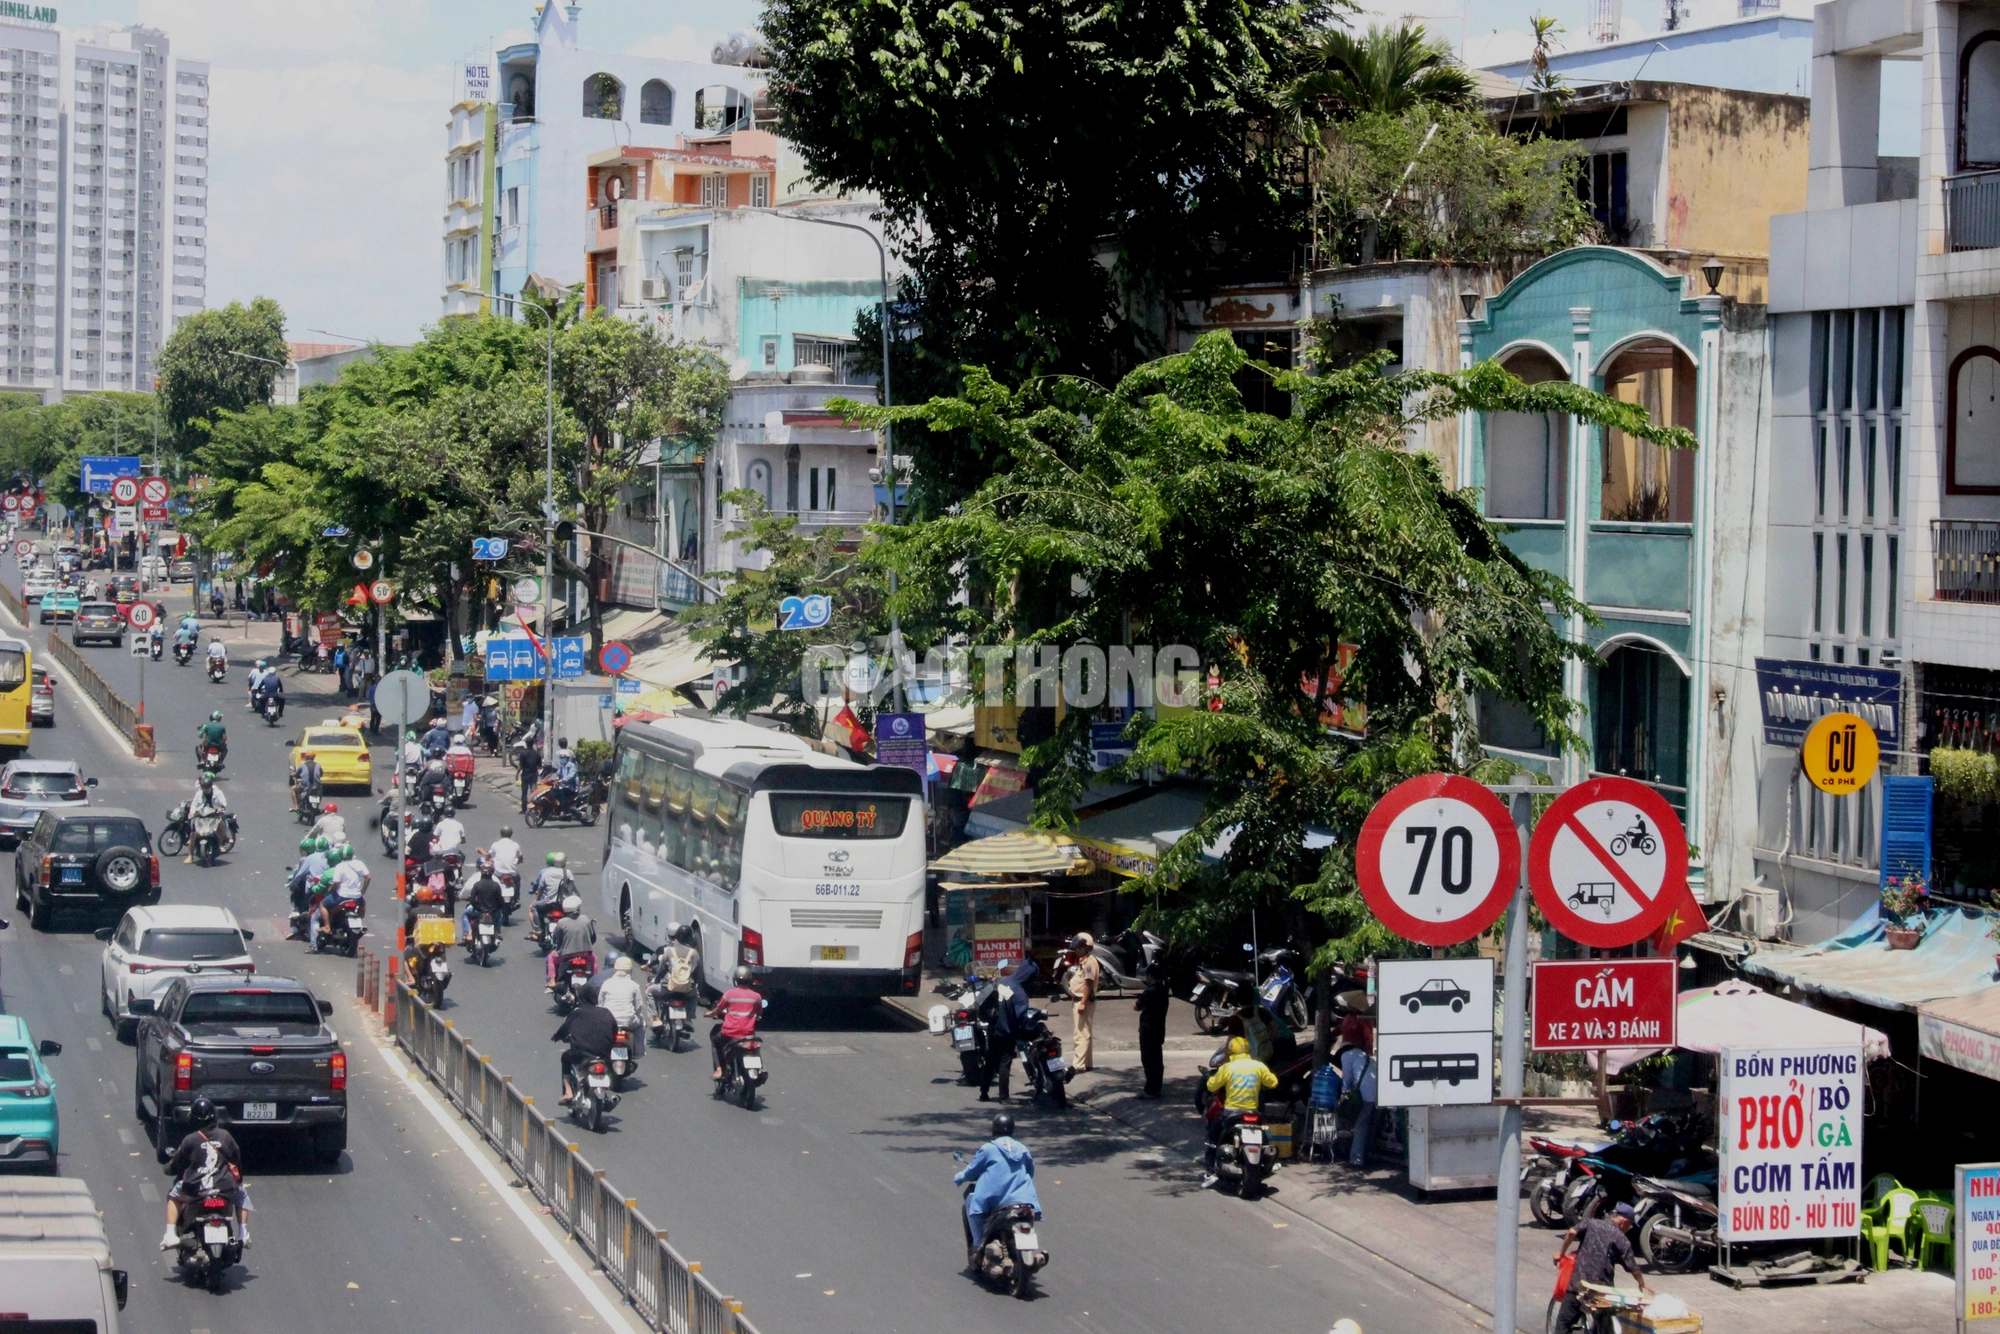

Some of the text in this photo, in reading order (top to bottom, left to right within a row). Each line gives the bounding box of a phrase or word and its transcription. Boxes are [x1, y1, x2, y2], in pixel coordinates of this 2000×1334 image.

[466, 66, 490, 78] HOTEL
[467, 80, 489, 88] MINH
[119, 484, 132, 497] 70
[376, 586, 388, 597] 50
[135, 609, 147, 622] 60
[849, 667, 871, 679] CIH
[1827, 724, 1857, 773] CŨ
[802, 810, 855, 829] QUANG
[1405, 826, 1473, 896] 70
[815, 884, 860, 896] 66B-011.22
[977, 940, 1006, 951] BÁNH
[981, 951, 1017, 959] HEO QUAY
[1575, 968, 1634, 1009] CẤM
[1548, 1016, 1660, 1040] XE 2 VÀ 3 BÁNH
[1735, 1050, 1857, 1078] BỐN PHƯƠNG
[1738, 1078, 1850, 1151] PHỞ BÒ
[1817, 1115, 1852, 1147] GÀ
[1733, 1152, 1855, 1195] CƠM TẤM
[1733, 1201, 1765, 1232] BÚN
[1769, 1199, 1790, 1230] BÒ
[1806, 1194, 1827, 1229] HỦ
[1832, 1197, 1856, 1228] TÍU
[1972, 1240, 1988, 1253] QUA
